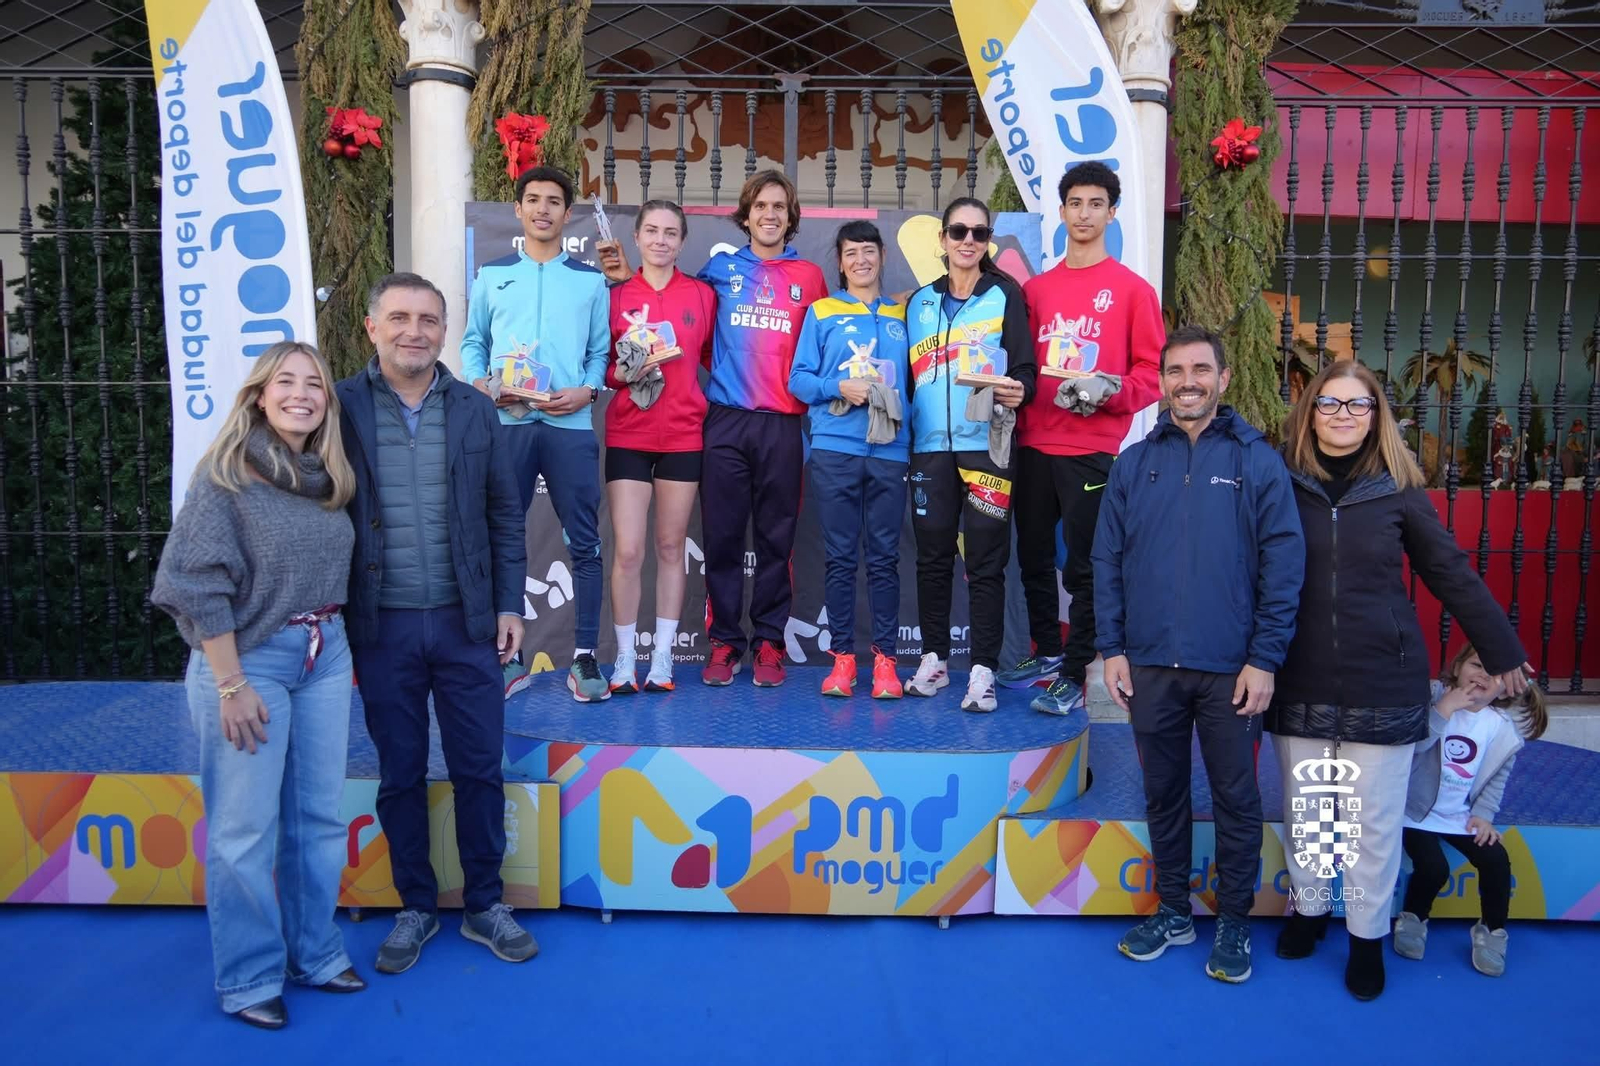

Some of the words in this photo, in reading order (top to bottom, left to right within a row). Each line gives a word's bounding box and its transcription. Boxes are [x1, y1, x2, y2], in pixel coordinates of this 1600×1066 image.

[736, 304, 754, 313] CLUB
[754, 306, 790, 319] ATLETISMO
[730, 312, 792, 334] DELSUR
[916, 335, 940, 356] CLUB
[978, 474, 1003, 490] CLUB
[813, 859, 944, 895] moguer
